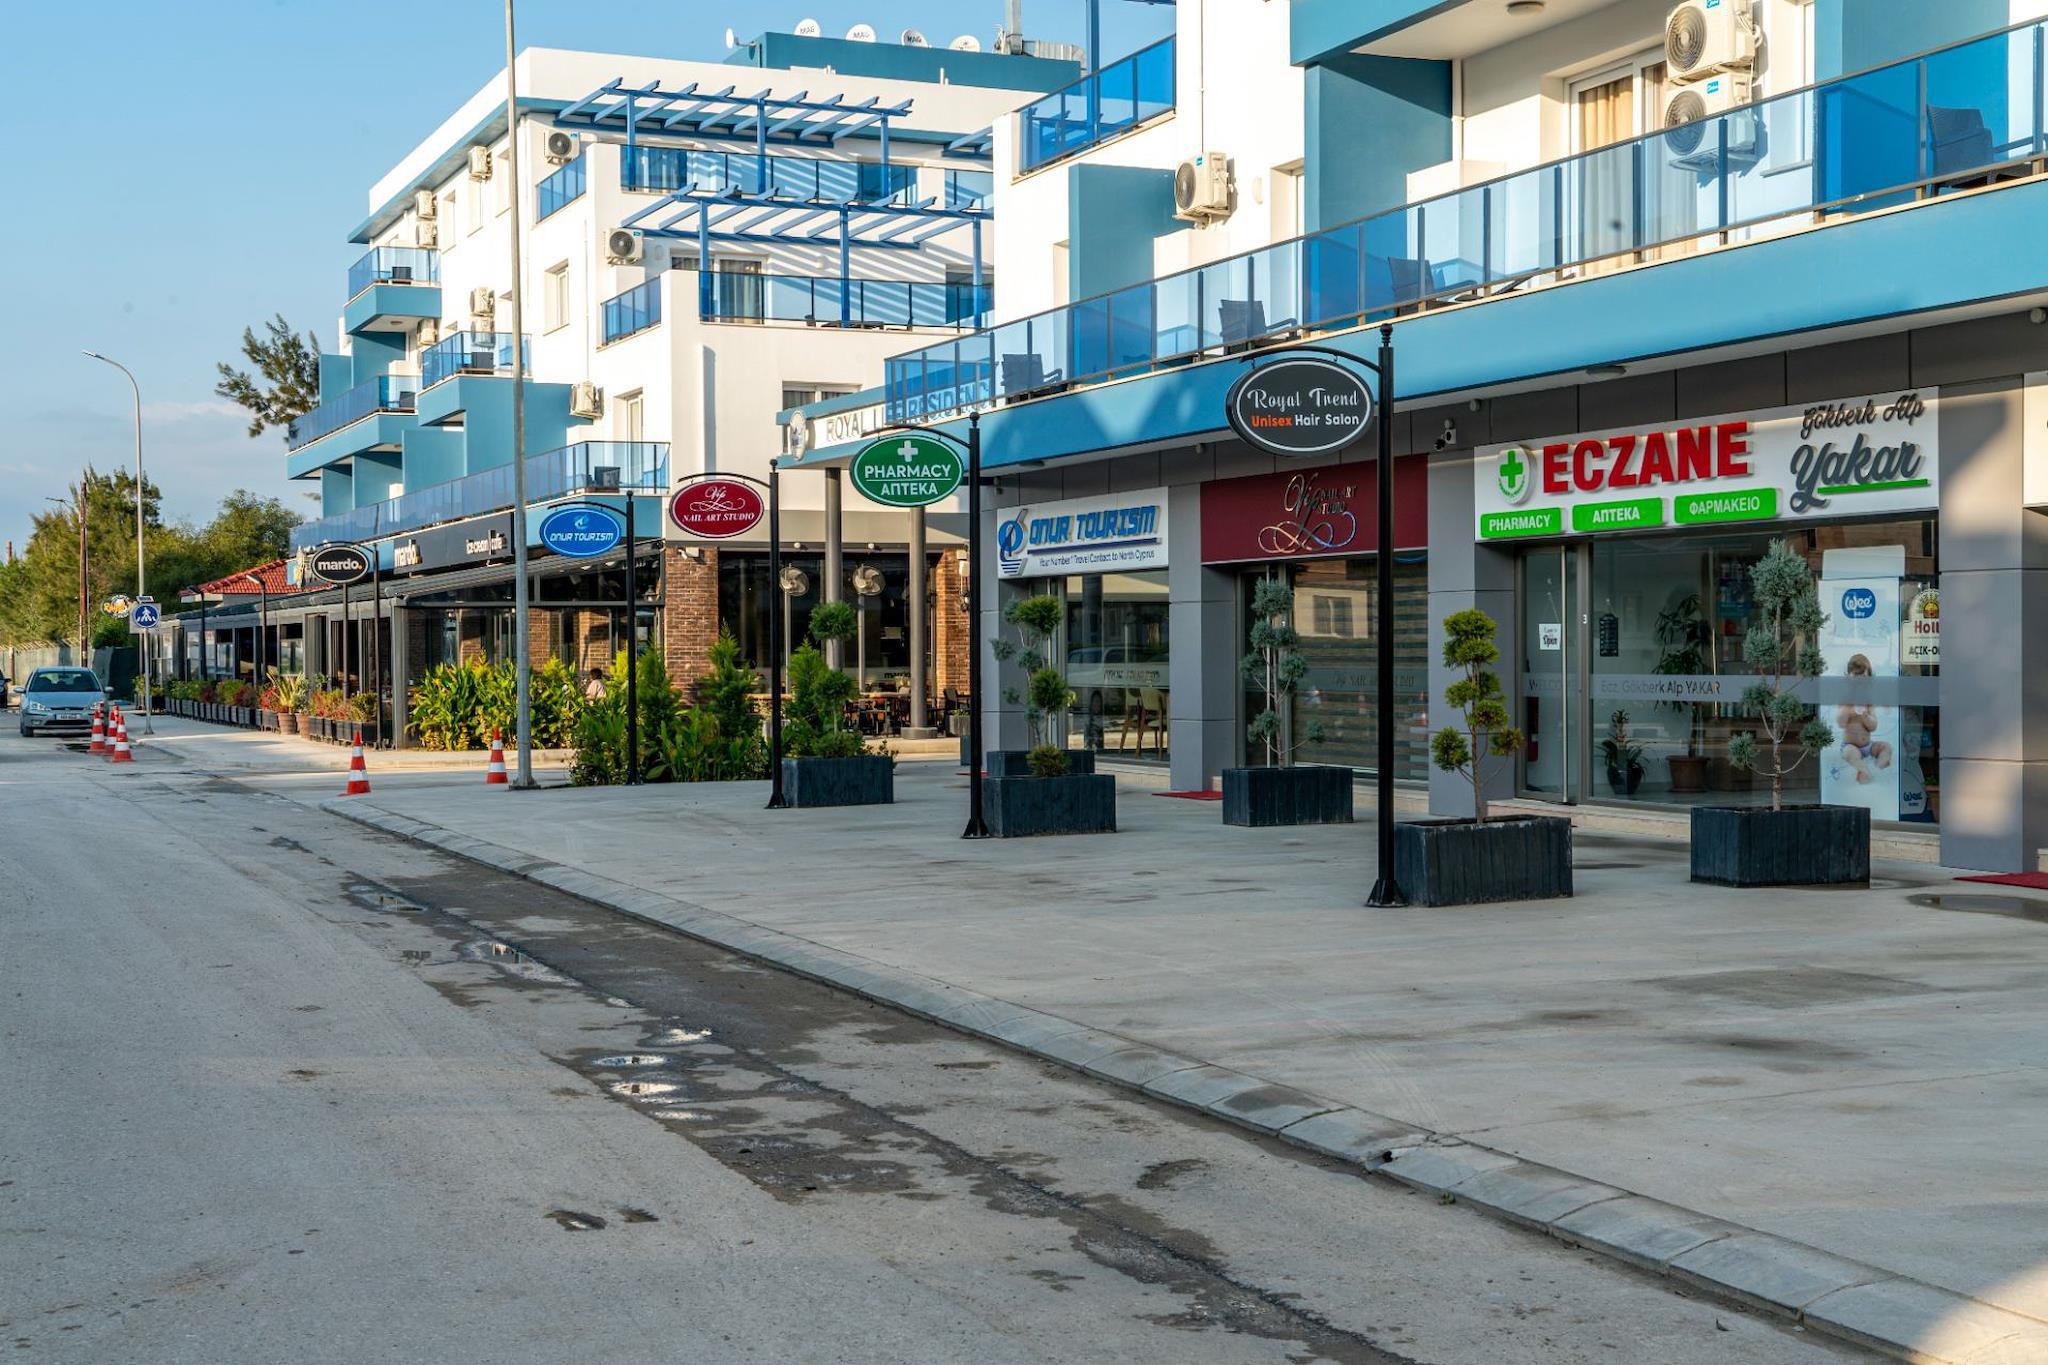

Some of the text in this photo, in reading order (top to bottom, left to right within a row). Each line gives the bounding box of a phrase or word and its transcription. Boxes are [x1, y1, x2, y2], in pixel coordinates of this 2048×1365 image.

[1247, 387, 1358, 412] Royal Trend
[1251, 412, 1360, 428] Unisex Hair Salon
[1800, 393, 1926, 440] Gökberk Alp
[826, 411, 867, 441] ROYAL
[1543, 421, 1750, 495] ECZANE
[864, 464, 951, 479] PHARMACY
[1789, 433, 1922, 513] Yakar
[881, 482, 938, 497] АПТЕКА
[682, 512, 755, 522] NAIL ART STUDIO
[1592, 506, 1640, 523] АПТЕКА
[1029, 505, 1158, 545] ONUR TOURISM
[1489, 514, 1551, 532] PHARMACY
[550, 532, 614, 542] ONUR TOURISM
[1845, 595, 1873, 611] Wee
[1909, 645, 1940, 659] AÇIK-O
[1666, 680, 1683, 696] Alp
[1685, 680, 1721, 695] YAKAR
